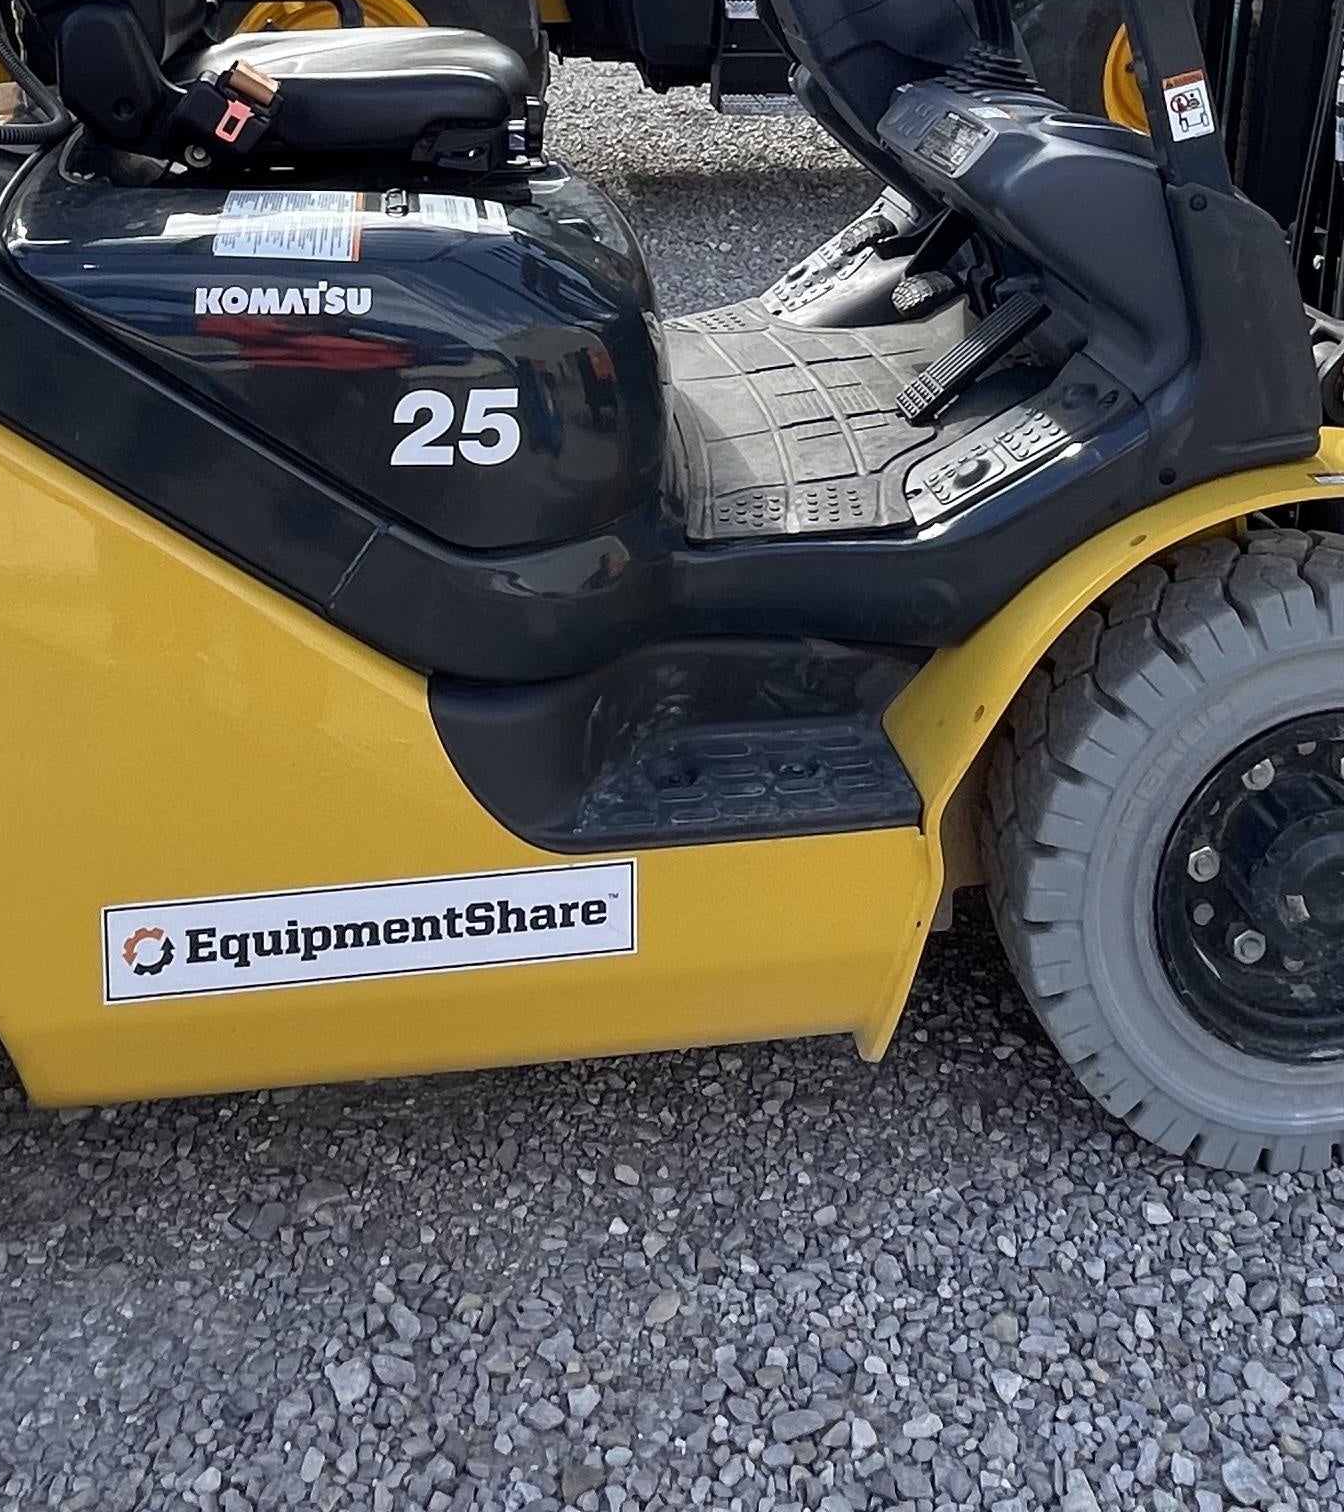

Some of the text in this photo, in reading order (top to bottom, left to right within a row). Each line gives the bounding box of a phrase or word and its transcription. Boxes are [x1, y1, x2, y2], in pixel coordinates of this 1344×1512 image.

[195, 281, 372, 315] KOMATSU
[391, 389, 521, 466] 25
[185, 899, 608, 968] EquipmentShare
